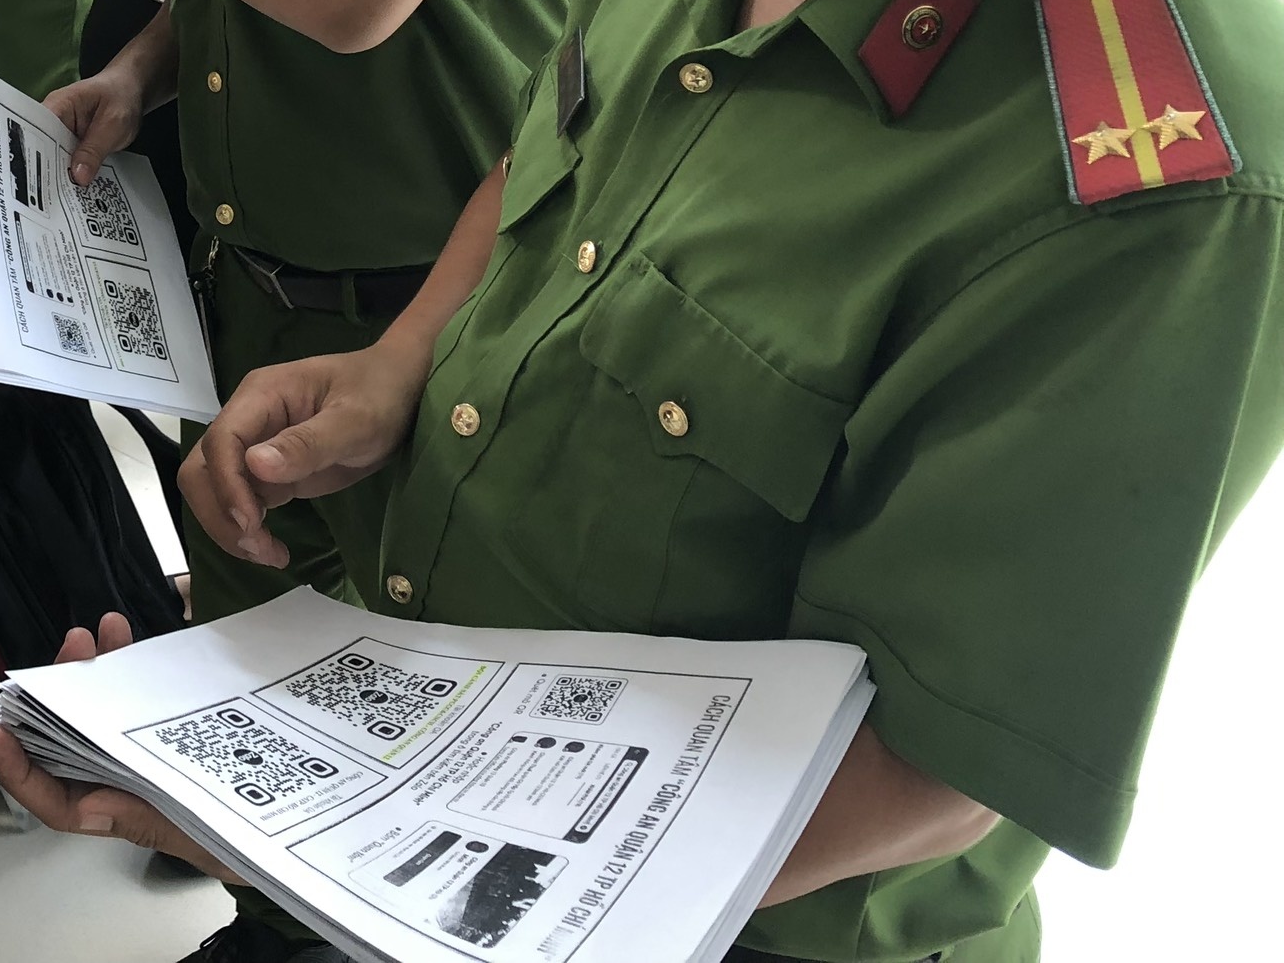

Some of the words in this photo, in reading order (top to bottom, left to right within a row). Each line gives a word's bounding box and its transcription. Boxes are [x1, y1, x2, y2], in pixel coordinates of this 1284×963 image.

[2, 223, 9, 235] AN
[9, 266, 18, 284] TÂM
[13, 286, 23, 308] QUAN
[17, 310, 28, 331] CÁCH
[700, 694, 733, 722] CÁCH
[474, 738, 485, 746] an
[683, 722, 716, 753] QUAN
[445, 766, 460, 774] TP
[669, 755, 700, 778] TÂM
[634, 813, 661, 831] AN
[610, 829, 651, 863] QUẬN
[601, 858, 627, 876] 12
[591, 871, 617, 891] TP
[576, 886, 607, 912] HỒ
[560, 904, 592, 932] CHÍ
